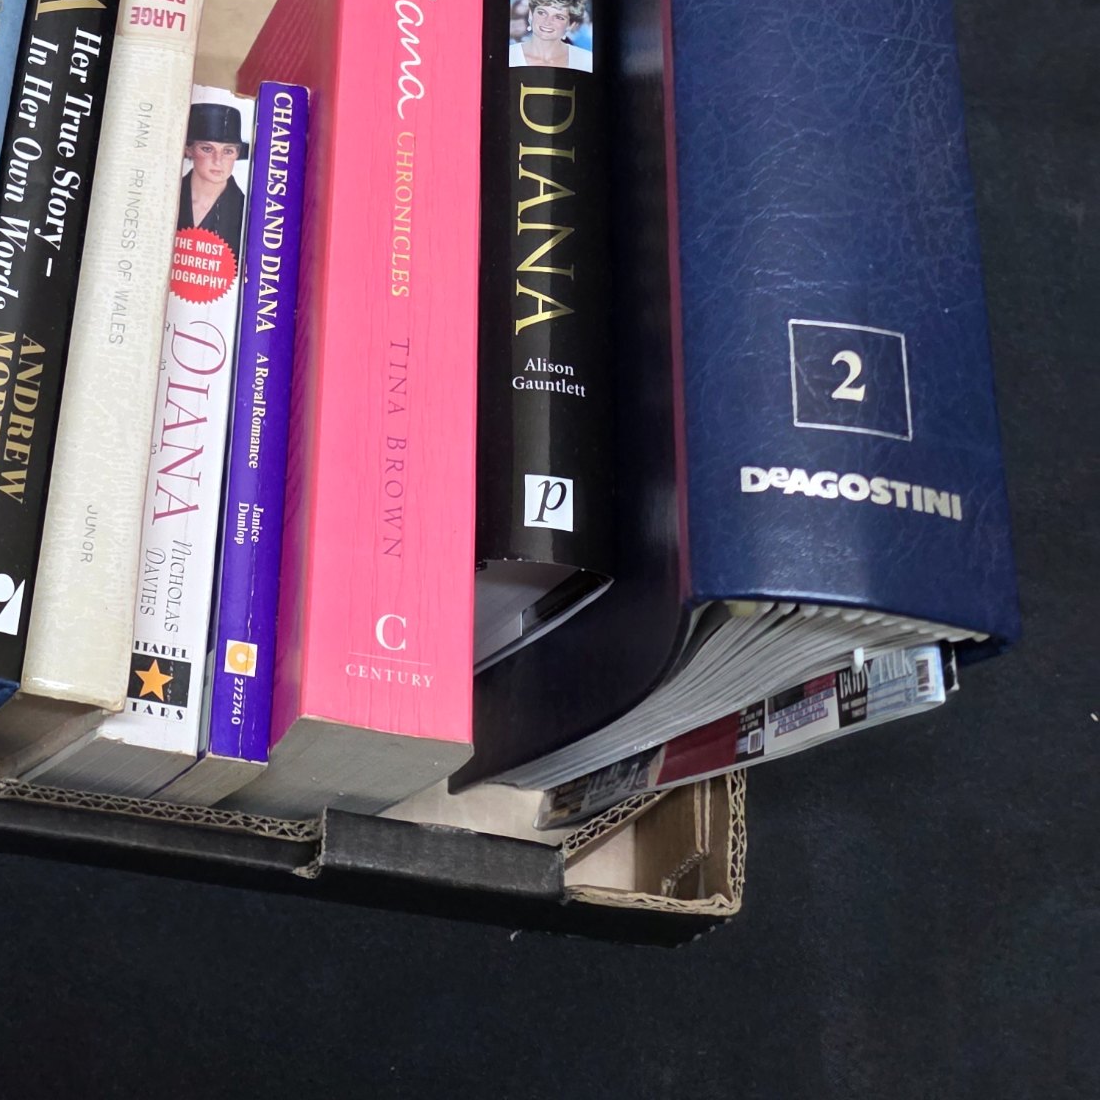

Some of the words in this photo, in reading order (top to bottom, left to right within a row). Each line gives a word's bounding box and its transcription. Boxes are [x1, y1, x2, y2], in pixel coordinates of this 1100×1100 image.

[129, 6, 186, 32] LARGE
[27, 34, 60, 66] In
[69, 26, 102, 84] Her
[18, 72, 53, 129] Her
[57, 91, 93, 158] True
[134, 102, 153, 150] DIANA
[4, 136, 42, 203] Own
[266, 91, 293, 197] CHARLES
[34, 166, 81, 251] Story
[120, 168, 145, 251] PRINCESS
[261, 197, 285, 250] AND
[391, 131, 415, 297] CHRONICLES
[515, 82, 576, 336] DIANA
[117, 259, 133, 282] OF
[173, 252, 221, 272] CURRENT
[174, 236, 193, 251] THE
[196, 240, 224, 257] MOST
[171, 267, 228, 290] IOGRAPHY!
[255, 254, 281, 334] DIANA
[108, 290, 130, 346] WALES
[256, 352, 269, 363] A
[388, 338, 410, 416] TINA
[524, 358, 574, 377] Alison
[831, 350, 866, 402] 2
[252, 366, 269, 405] Royal
[512, 376, 586, 398] Gauntlett
[152, 320, 227, 525] DIANA
[248, 406, 266, 469] Romance
[251, 503, 264, 543] Janice
[383, 435, 408, 559] BROWN
[80, 504, 99, 564] JUNOR
[234, 502, 250, 545] Dunlop
[140, 547, 166, 617] DAVIES
[164, 539, 193, 633] NICHOLAS
[134, 640, 190, 659] ITADEL
[375, 613, 407, 651] C
[231, 677, 244, 725] 272740
[345, 663, 435, 689] CENTURY
[131, 701, 185, 721] TARS
